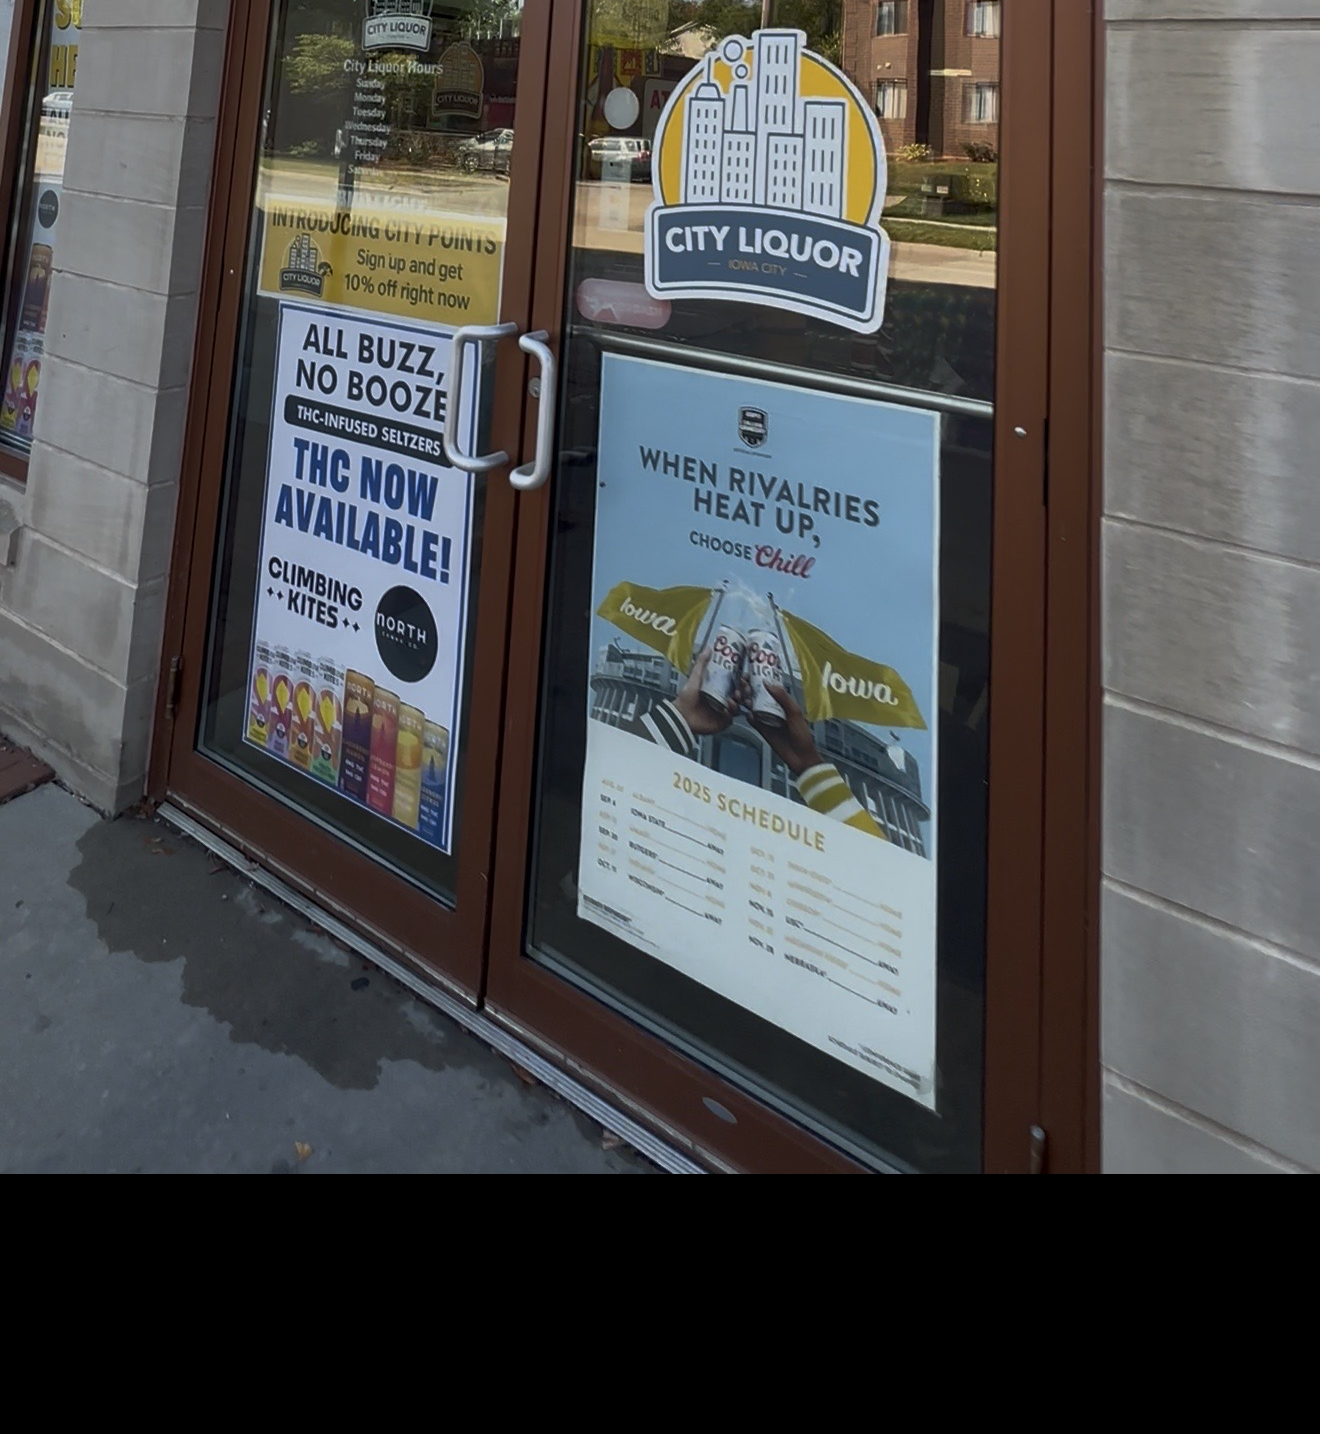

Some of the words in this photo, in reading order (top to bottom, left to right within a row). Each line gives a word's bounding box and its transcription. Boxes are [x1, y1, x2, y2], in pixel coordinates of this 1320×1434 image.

[367, 22, 388, 35] CITY
[389, 21, 427, 36] LIQUOR
[343, 59, 366, 75] City
[367, 60, 405, 75] Liquor
[407, 60, 444, 75] Hours
[356, 78, 385, 90] Sunday
[353, 107, 386, 120] Tuesday
[354, 92, 386, 105] Monday
[345, 121, 391, 135] Wednesday
[350, 135, 388, 149] Thursday
[354, 150, 381, 163] Friday
[272, 206, 380, 241] INTRODUCING
[384, 218, 425, 245] CITY
[428, 223, 497, 255] POINTS
[665, 225, 731, 253] CITY
[738, 226, 864, 278] LIQUOR
[283, 273, 297, 281] CITY
[297, 274, 320, 287] LIQUOR
[357, 248, 386, 271] Sign
[388, 255, 406, 274] up
[409, 258, 436, 276] and
[438, 263, 463, 282] get
[728, 259, 759, 271] IOWA
[761, 262, 788, 276] CITY
[344, 273, 375, 294] 10%
[378, 279, 398, 297] off
[400, 282, 434, 306] right
[437, 290, 471, 310] now
[302, 323, 348, 360] ALL
[358, 333, 445, 386] BUZZ,
[295, 358, 338, 395] NO
[347, 370, 448, 423] BOOZE
[297, 404, 378, 440] THC-INFUSED
[381, 426, 442, 457] SELTZERS
[293, 437, 351, 494] THC
[360, 455, 439, 522] NOW
[639, 445, 718, 488] WHEN
[729, 466, 880, 528] RIVALRIES
[274, 483, 452, 584] AVAILABLE!
[694, 487, 766, 527] HEAT
[775, 506, 821, 548] UP,
[689, 530, 753, 561] CHOOSE
[754, 544, 817, 579] Chill
[268, 556, 363, 612] CLIMBING
[287, 588, 339, 630] KITES
[620, 597, 678, 637] Iowa
[821, 661, 899, 708] Iowa
[672, 771, 711, 805] 2025
[717, 793, 827, 853] SCHEDULE
